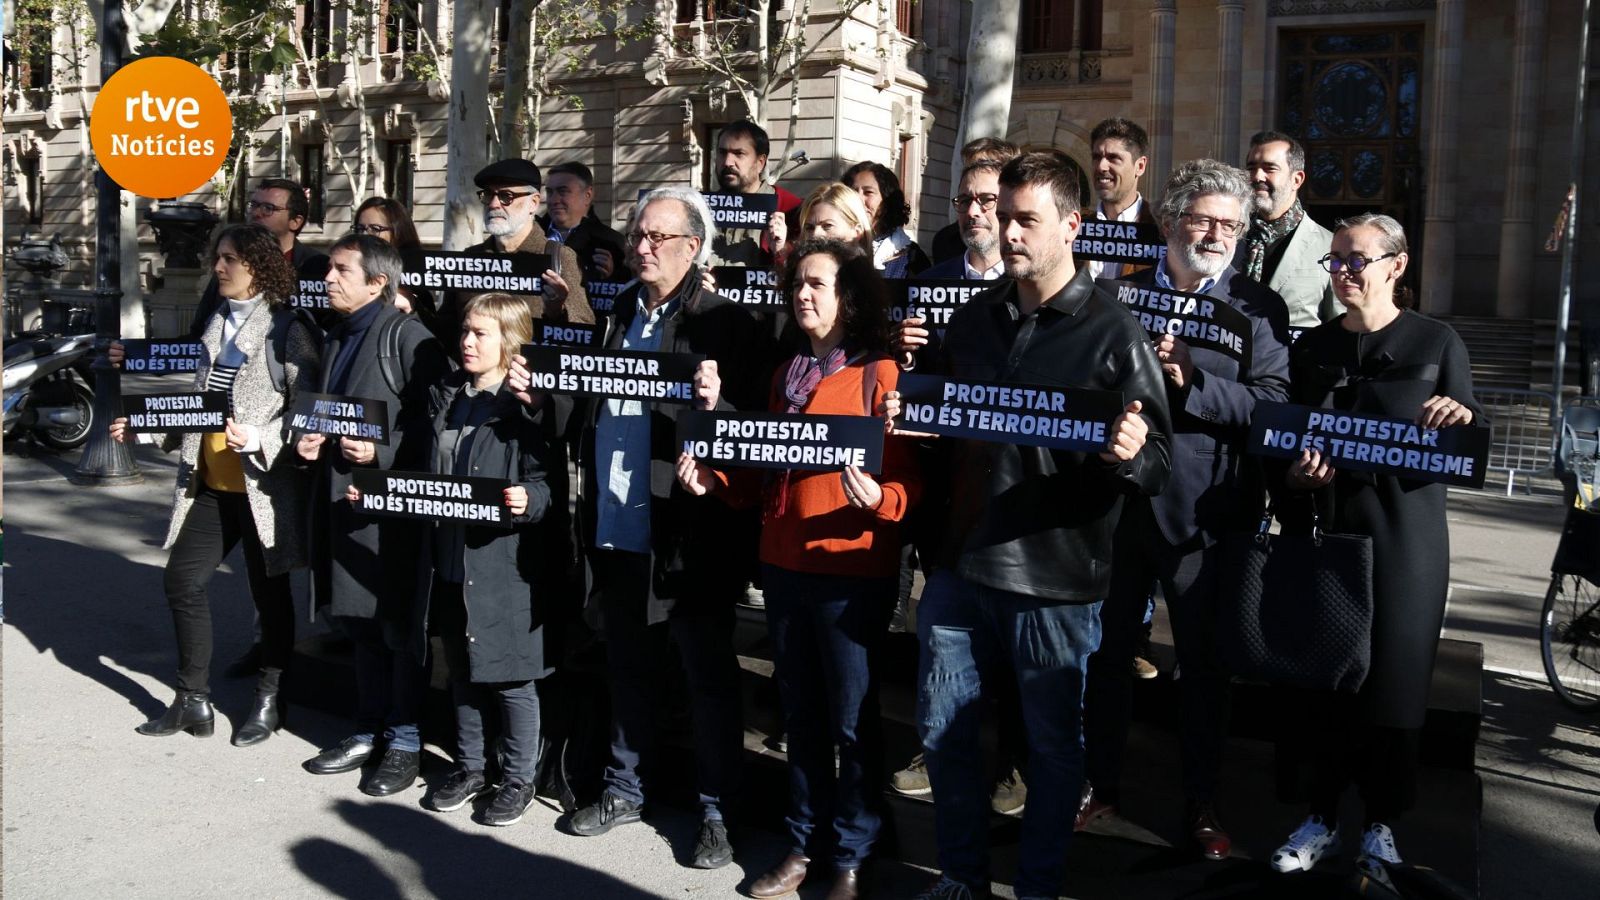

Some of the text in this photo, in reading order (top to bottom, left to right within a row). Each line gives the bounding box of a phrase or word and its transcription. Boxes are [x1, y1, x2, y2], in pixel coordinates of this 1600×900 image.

[710, 210, 767, 223] RORISME
[1078, 222, 1137, 239] TESTAR
[1072, 239, 1169, 258] ERRORISME
[425, 256, 513, 273] PROTESTAR
[401, 270, 541, 292] NO ÉS TERRORISME
[300, 292, 314, 308] ÉS
[743, 286, 762, 304] ÉS
[1117, 285, 1215, 319] PROTESTAR
[543, 325, 593, 344] PROTE
[1131, 310, 1243, 354] RRORISME
[125, 358, 146, 370] NO
[148, 356, 166, 370] ÉS
[560, 353, 659, 376] PROTESTAR
[532, 370, 693, 400] NO ÉS TERRORISME
[145, 396, 203, 410] PROTESTAR
[944, 382, 1065, 412] PROTESTAR
[130, 411, 224, 428] NO ÉS TERRORISME
[313, 399, 365, 418] PROTESTAR
[291, 413, 383, 440] NO ÉS TERRORISME
[715, 419, 829, 441] PROTESTAR
[905, 403, 1106, 442] NO ÉS TERRORISME
[1307, 412, 1438, 447] PROTESTAR
[684, 438, 866, 467] NO ÉS TERRORISME
[1263, 428, 1297, 450] NO
[1329, 438, 1474, 477] TERRORISME
[387, 477, 472, 499] PROTESTAR
[363, 491, 501, 522] NO ÉS TERRORISME
